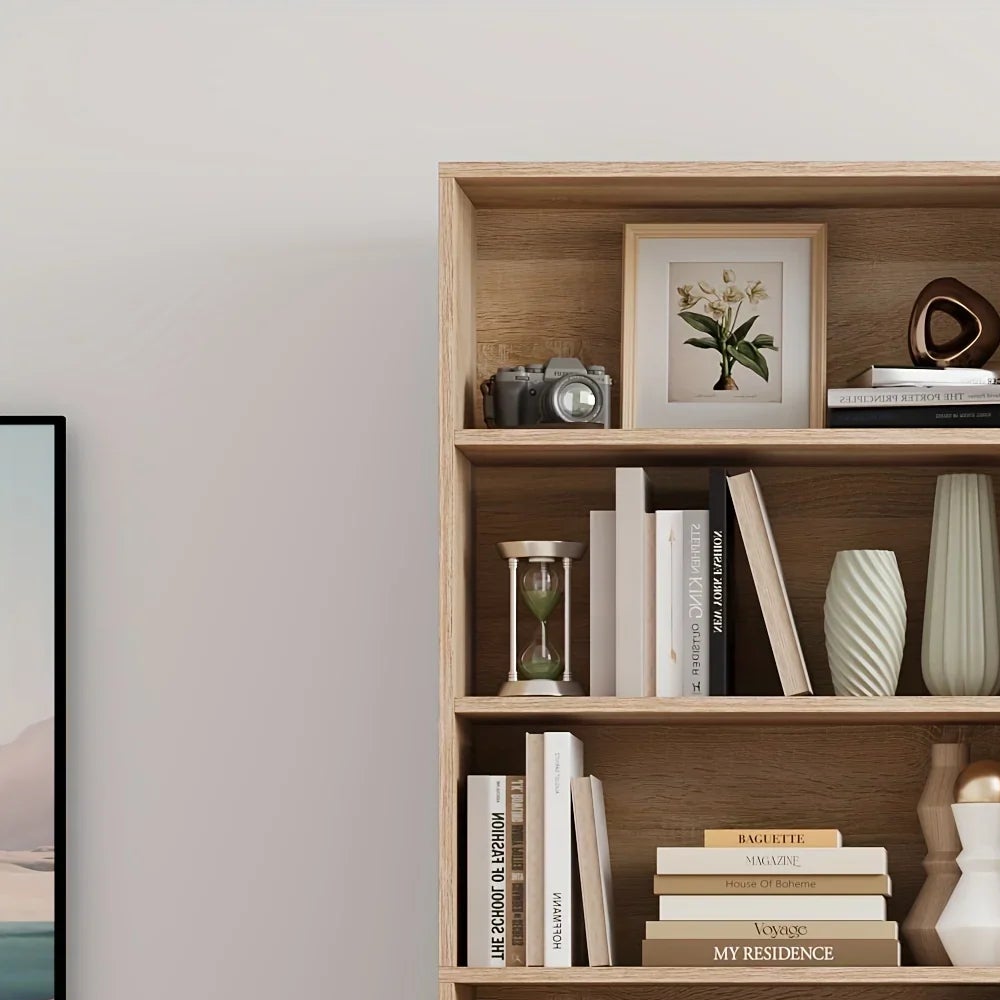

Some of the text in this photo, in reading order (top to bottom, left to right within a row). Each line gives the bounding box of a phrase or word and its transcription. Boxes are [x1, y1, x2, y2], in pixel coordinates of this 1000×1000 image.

[738, 833, 805, 844] BAGUETTE
[745, 855, 801, 868] MAGAZINE
[725, 879, 816, 889] House Of Boheme
[754, 922, 808, 939] Voyage
[713, 946, 834, 961] MY RESIDENCE
